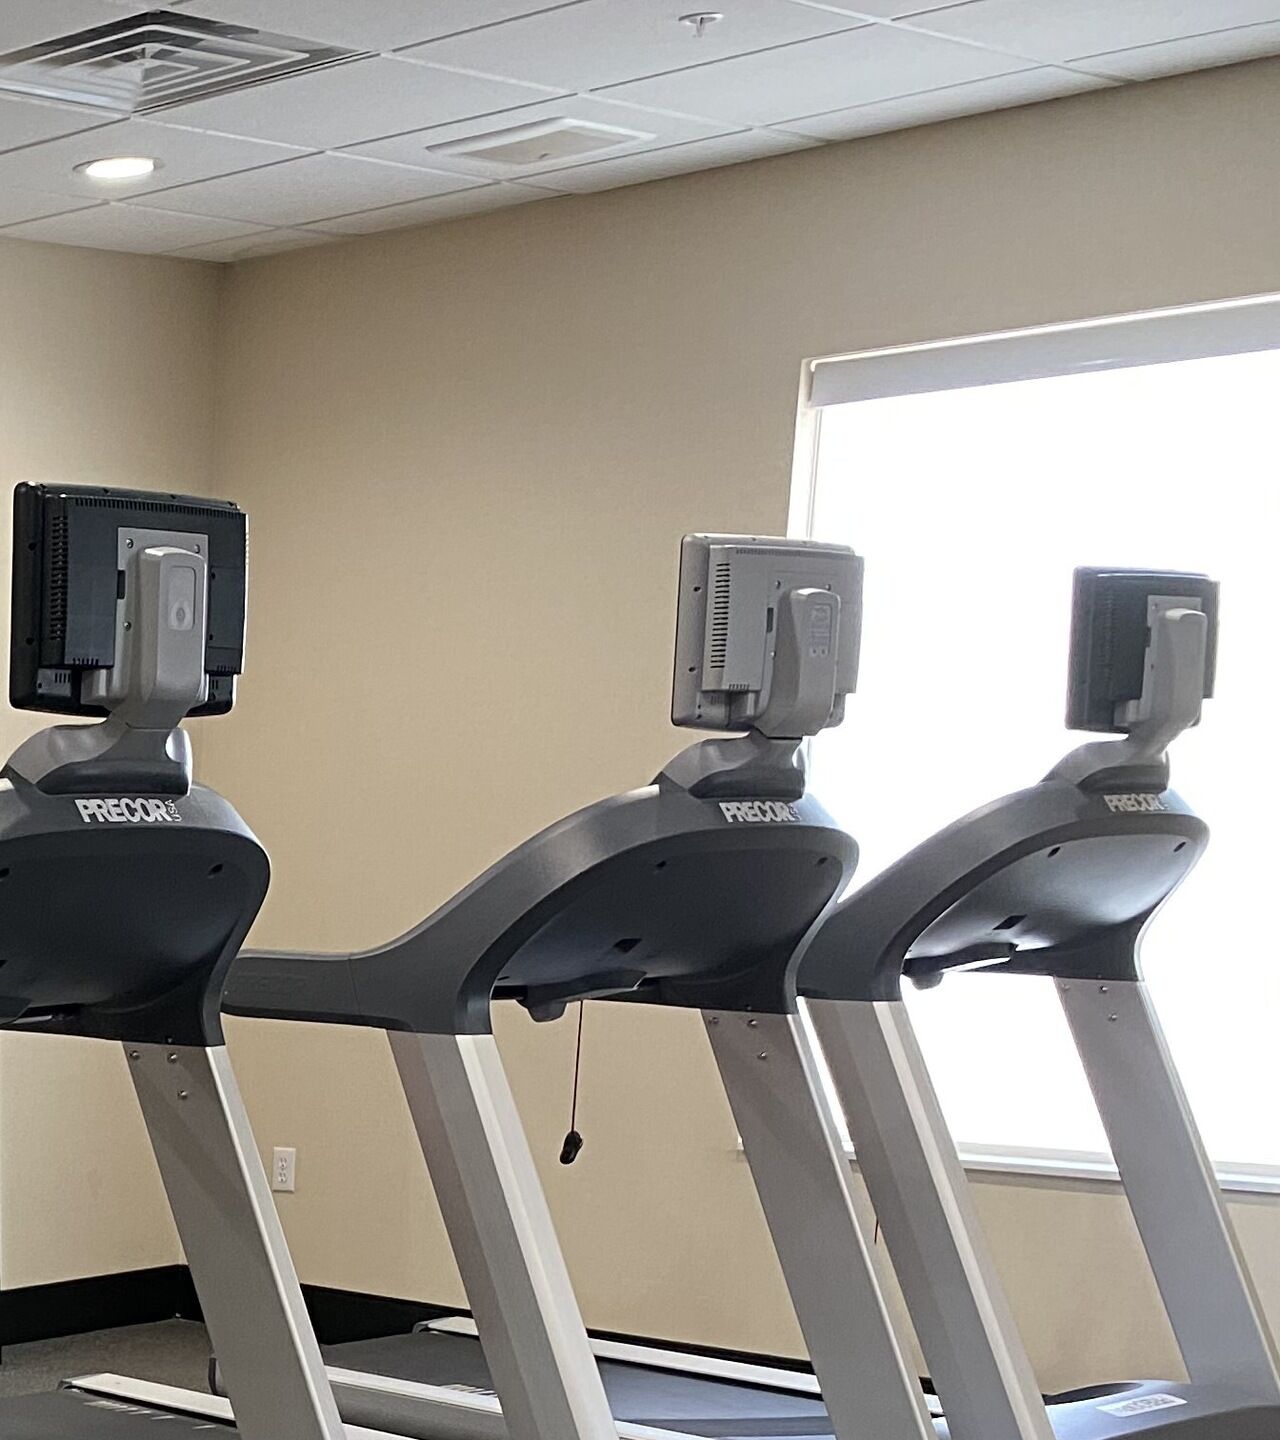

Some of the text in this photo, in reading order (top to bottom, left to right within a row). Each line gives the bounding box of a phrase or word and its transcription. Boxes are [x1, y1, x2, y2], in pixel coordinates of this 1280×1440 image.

[74, 797, 182, 823] PRECOR USA
[719, 800, 794, 823] PRECOR
